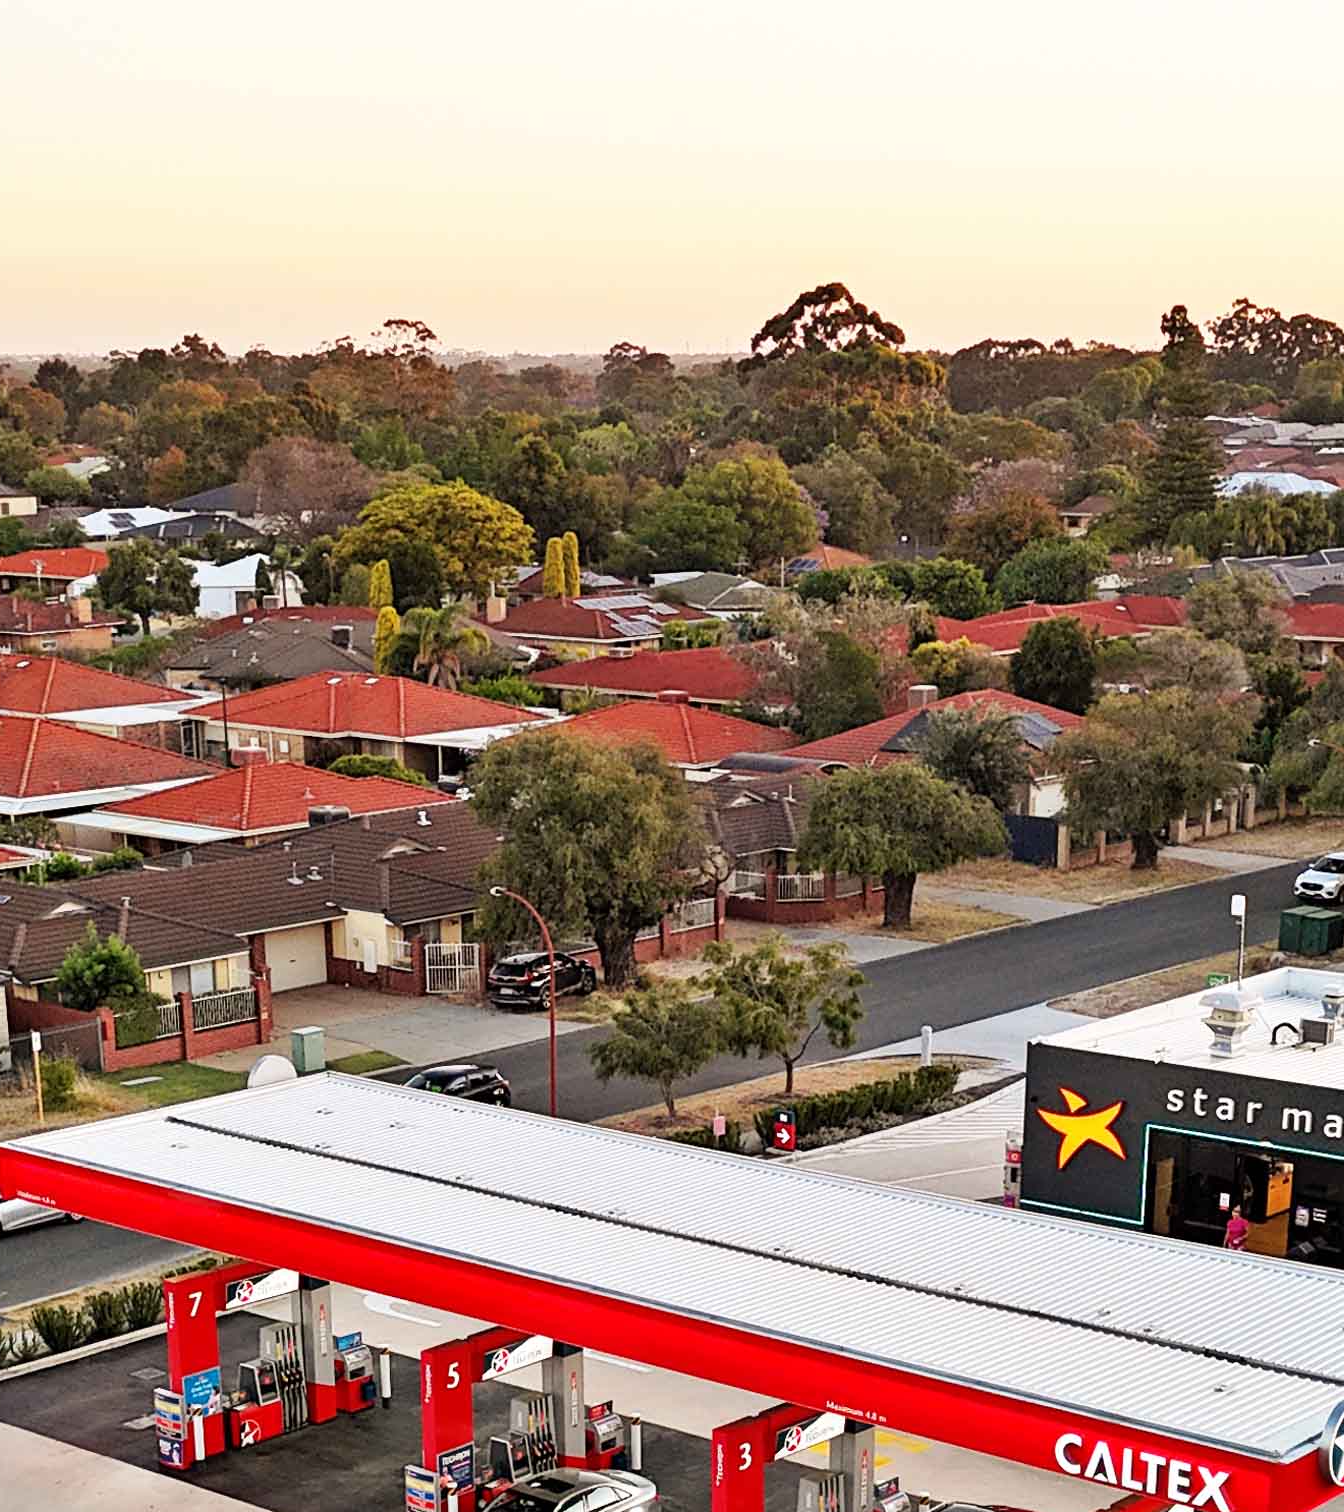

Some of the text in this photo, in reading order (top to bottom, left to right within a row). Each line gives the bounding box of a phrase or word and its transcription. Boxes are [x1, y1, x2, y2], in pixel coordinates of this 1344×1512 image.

[1167, 1087, 1263, 1124] star
[188, 1292, 202, 1317] 7
[446, 1361, 460, 1389] 5
[738, 1442, 753, 1471] 3
[1055, 1433, 1233, 1512] CALTEX
